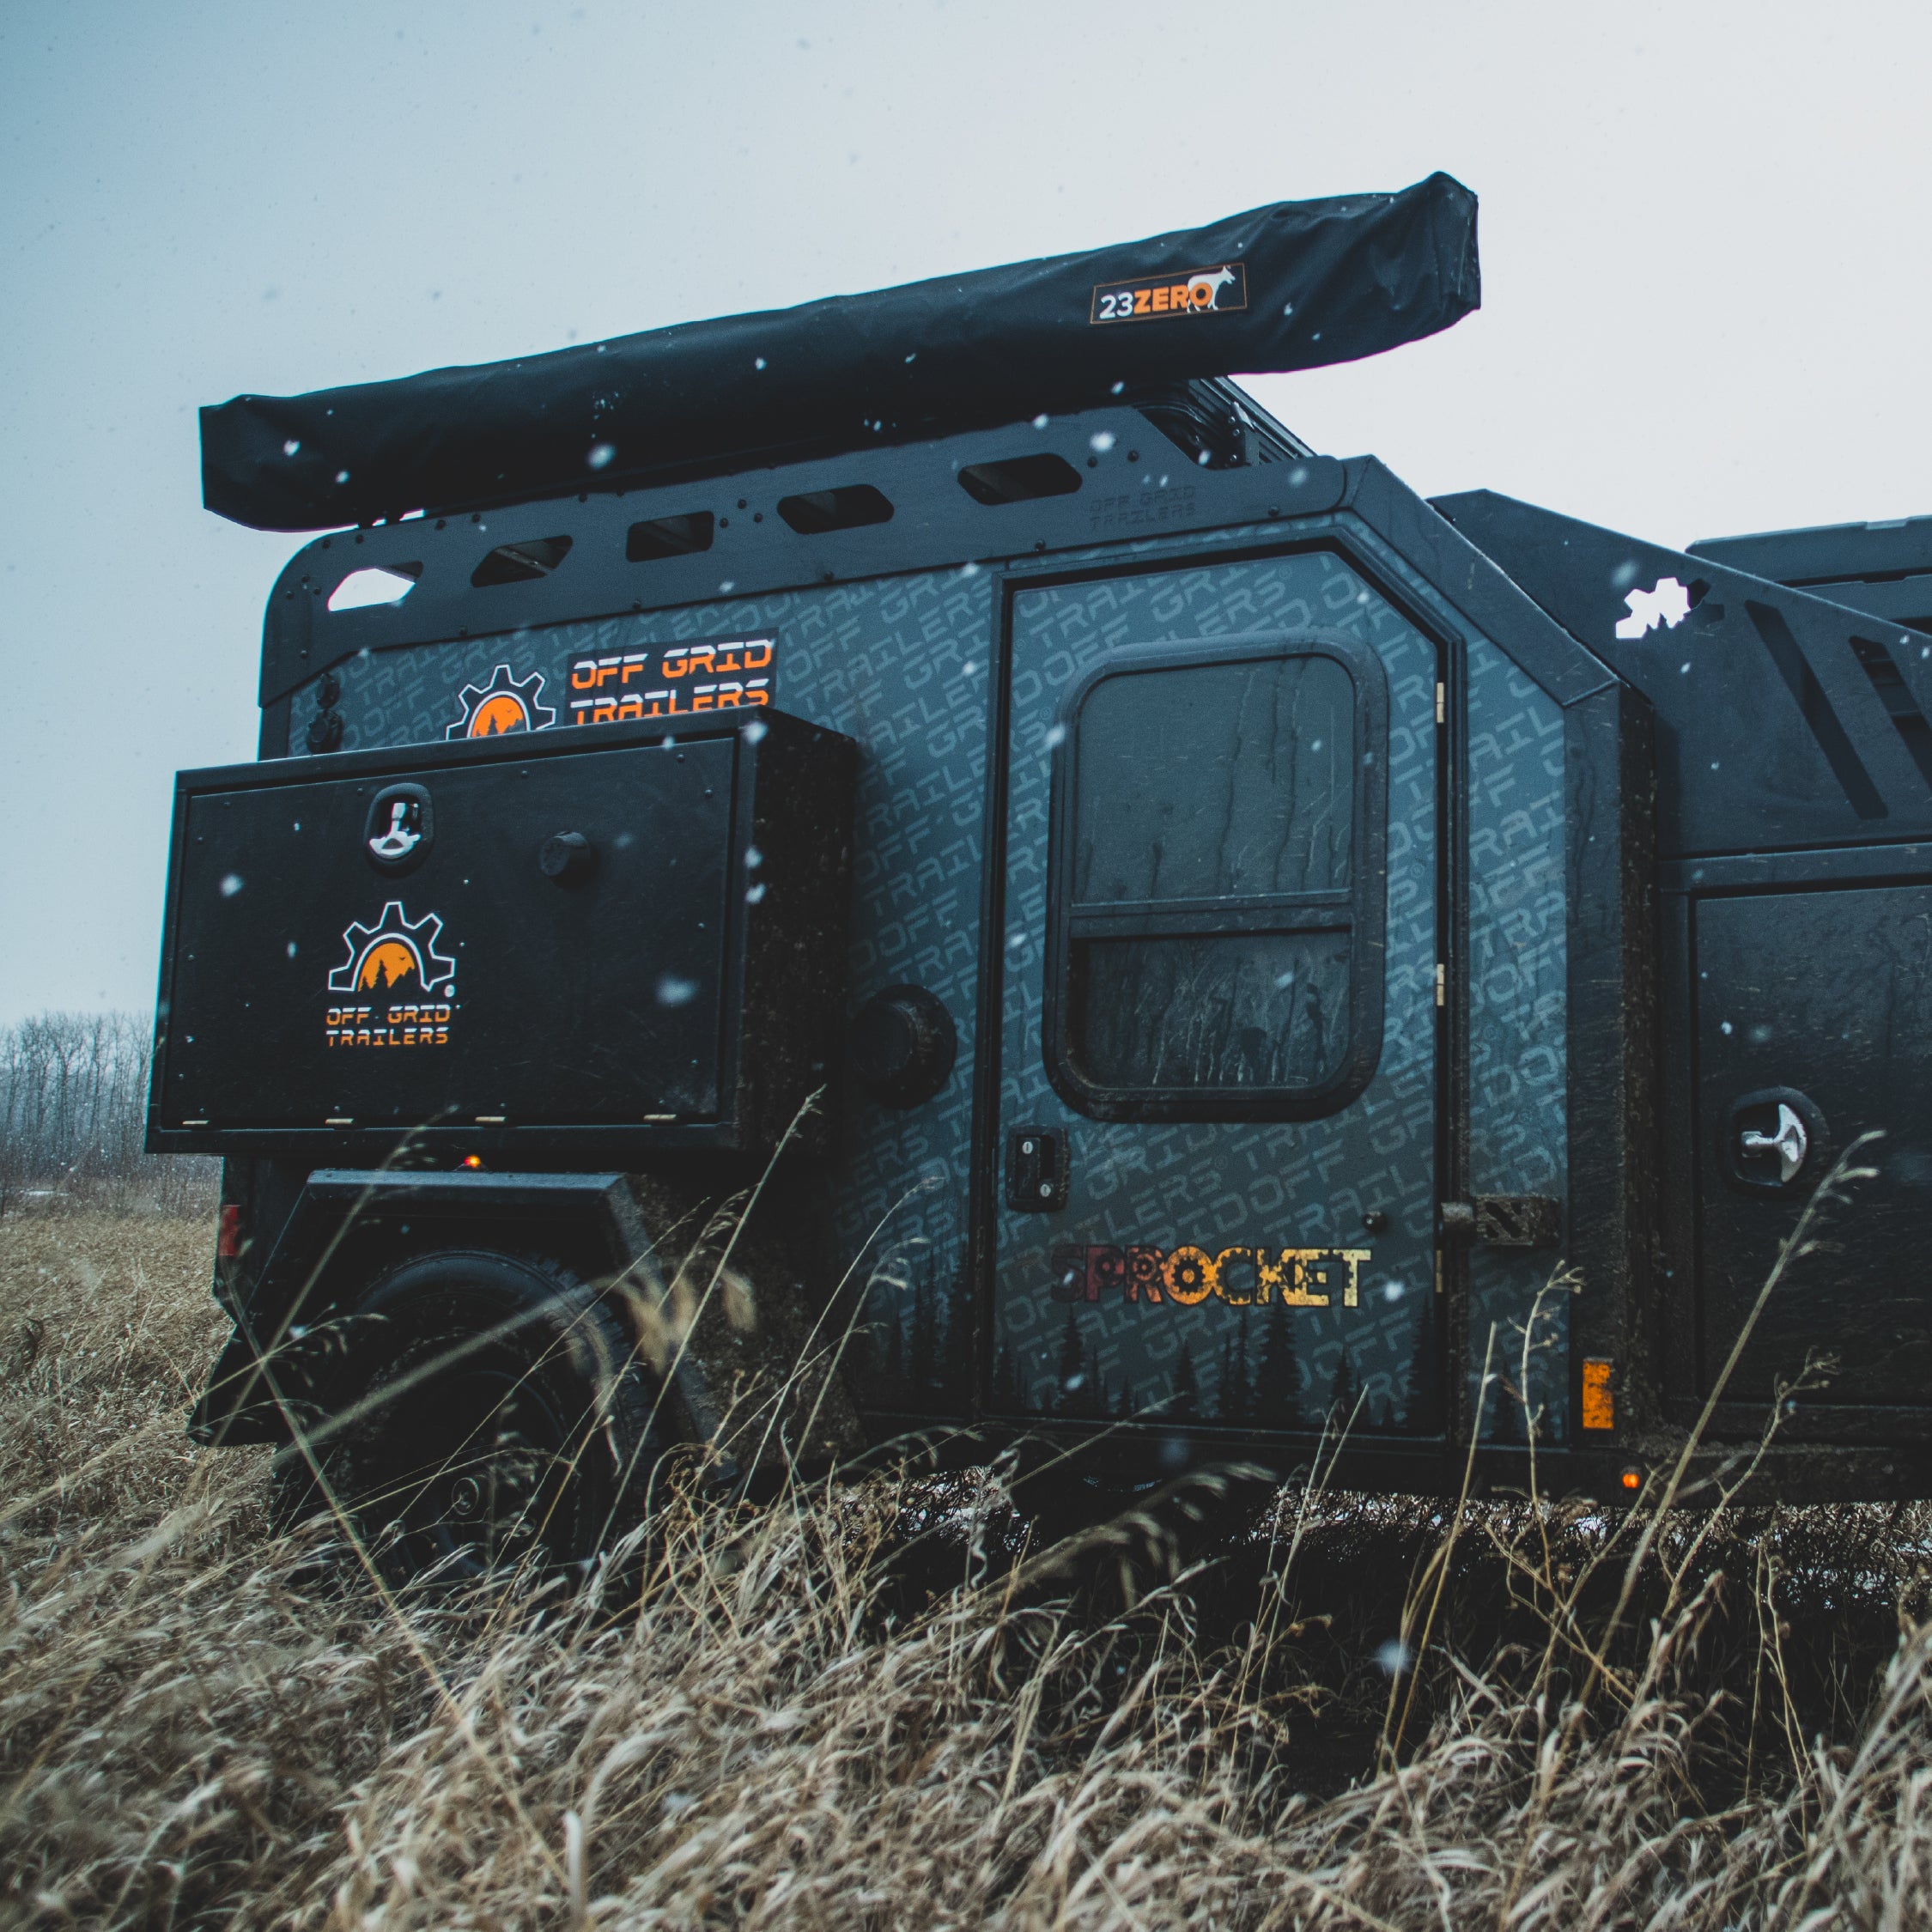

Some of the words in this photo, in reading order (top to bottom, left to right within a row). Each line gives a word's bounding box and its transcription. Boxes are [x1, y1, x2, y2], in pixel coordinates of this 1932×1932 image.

[1099, 281, 1213, 319] 23ZERO
[571, 653, 648, 690] OFF
[661, 638, 776, 679] GRID
[785, 616, 860, 683] OFF
[569, 677, 769, 726] TRAILERS
[878, 887, 958, 957] OFF
[325, 1006, 372, 1025] OFF
[387, 1004, 451, 1024] GRID
[325, 1026, 451, 1048] TRAILERS
[1249, 1139, 1345, 1213] OFF
[1050, 1245, 1372, 1308] SPROCKET
